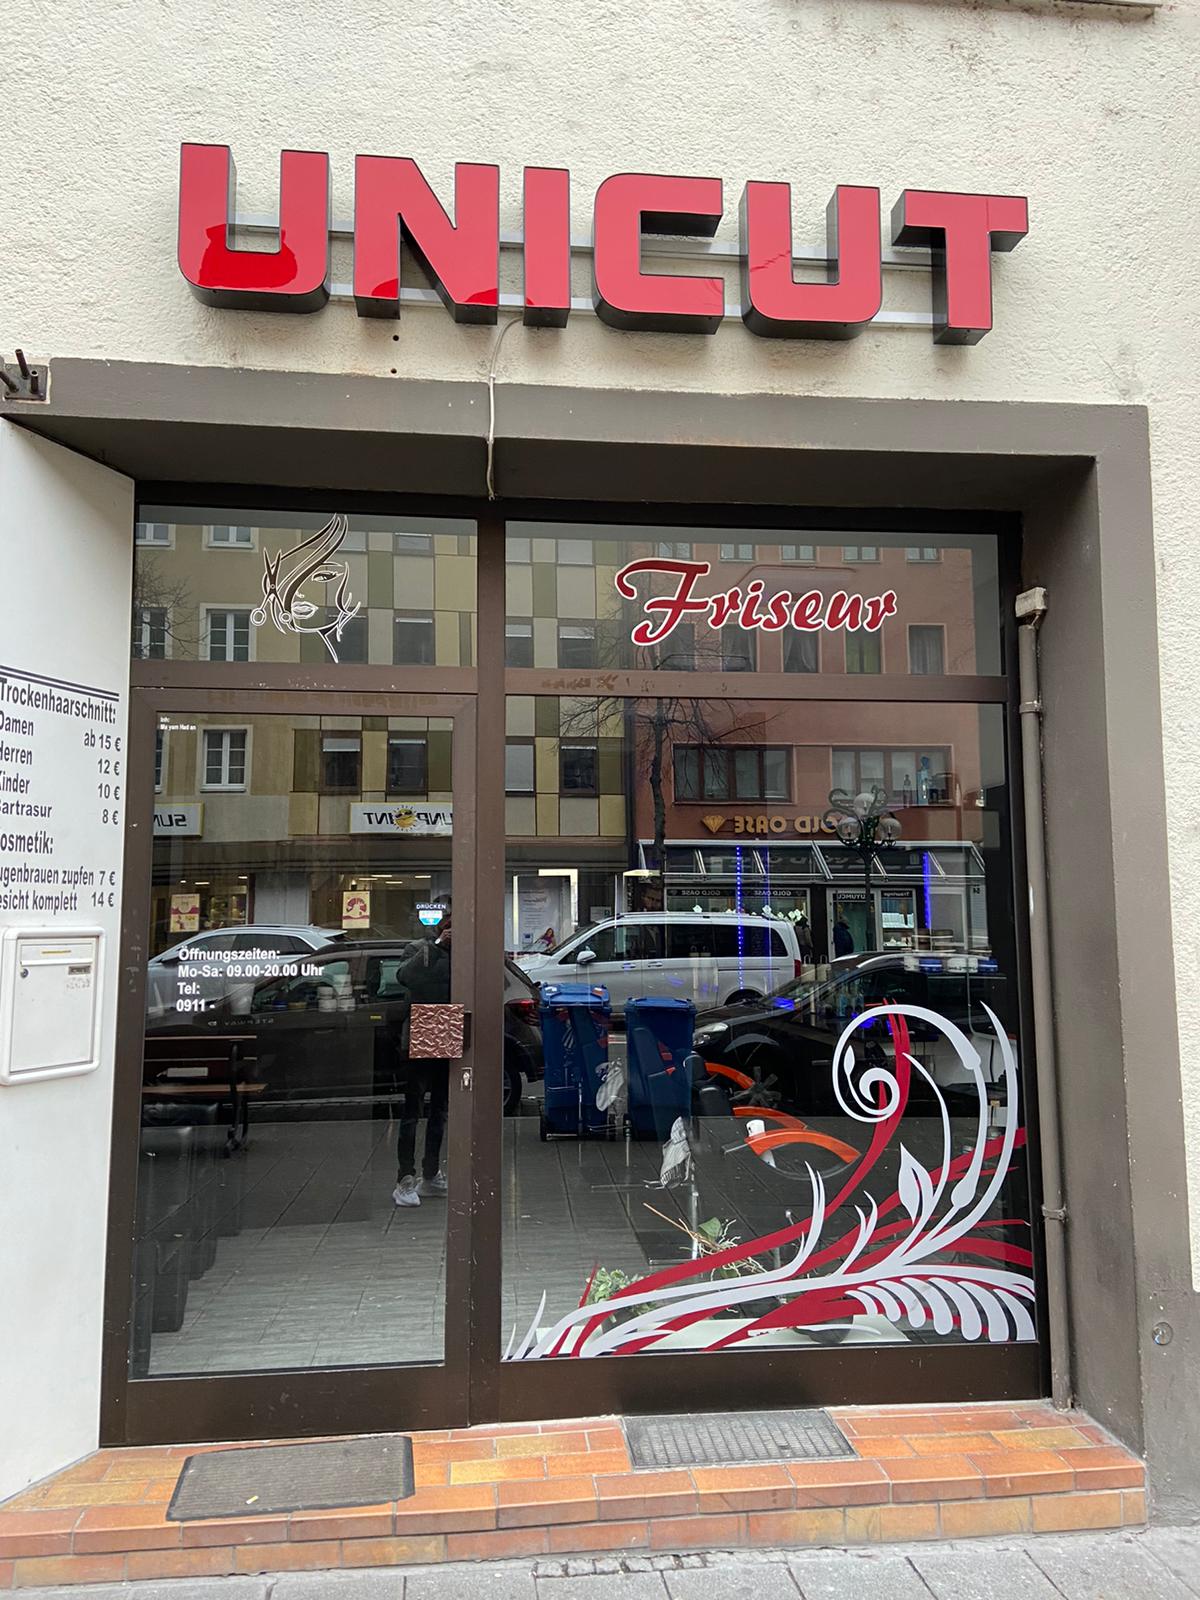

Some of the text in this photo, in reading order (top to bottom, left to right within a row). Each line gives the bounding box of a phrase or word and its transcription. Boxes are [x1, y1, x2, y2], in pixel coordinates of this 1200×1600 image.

[177, 142, 1028, 340] UNICUT
[615, 558, 897, 646] Friseur
[0, 678, 116, 724] Trockenhaarschnitt:
[84, 729, 96, 748] ab
[99, 733, 112, 750] 15
[115, 737, 121, 752] €
[98, 758, 111, 775] 12
[114, 761, 120, 776] €
[98, 783, 111, 799] 10
[114, 786, 120, 801] €
[0, 800, 118, 825] artrasur 8 €
[62, 865, 94, 890] zupfen
[99, 871, 106, 886] 7
[109, 871, 115, 886] €
[32, 889, 77, 915] komplett
[91, 891, 104, 907] 14
[108, 892, 114, 908] €
[178, 945, 281, 962] Öffnungszeiten:
[178, 964, 324, 978] Mo-Sa: 09.00-20.00 Uhr
[177, 982, 201, 995] Tel:
[176, 999, 206, 1012] 0911
